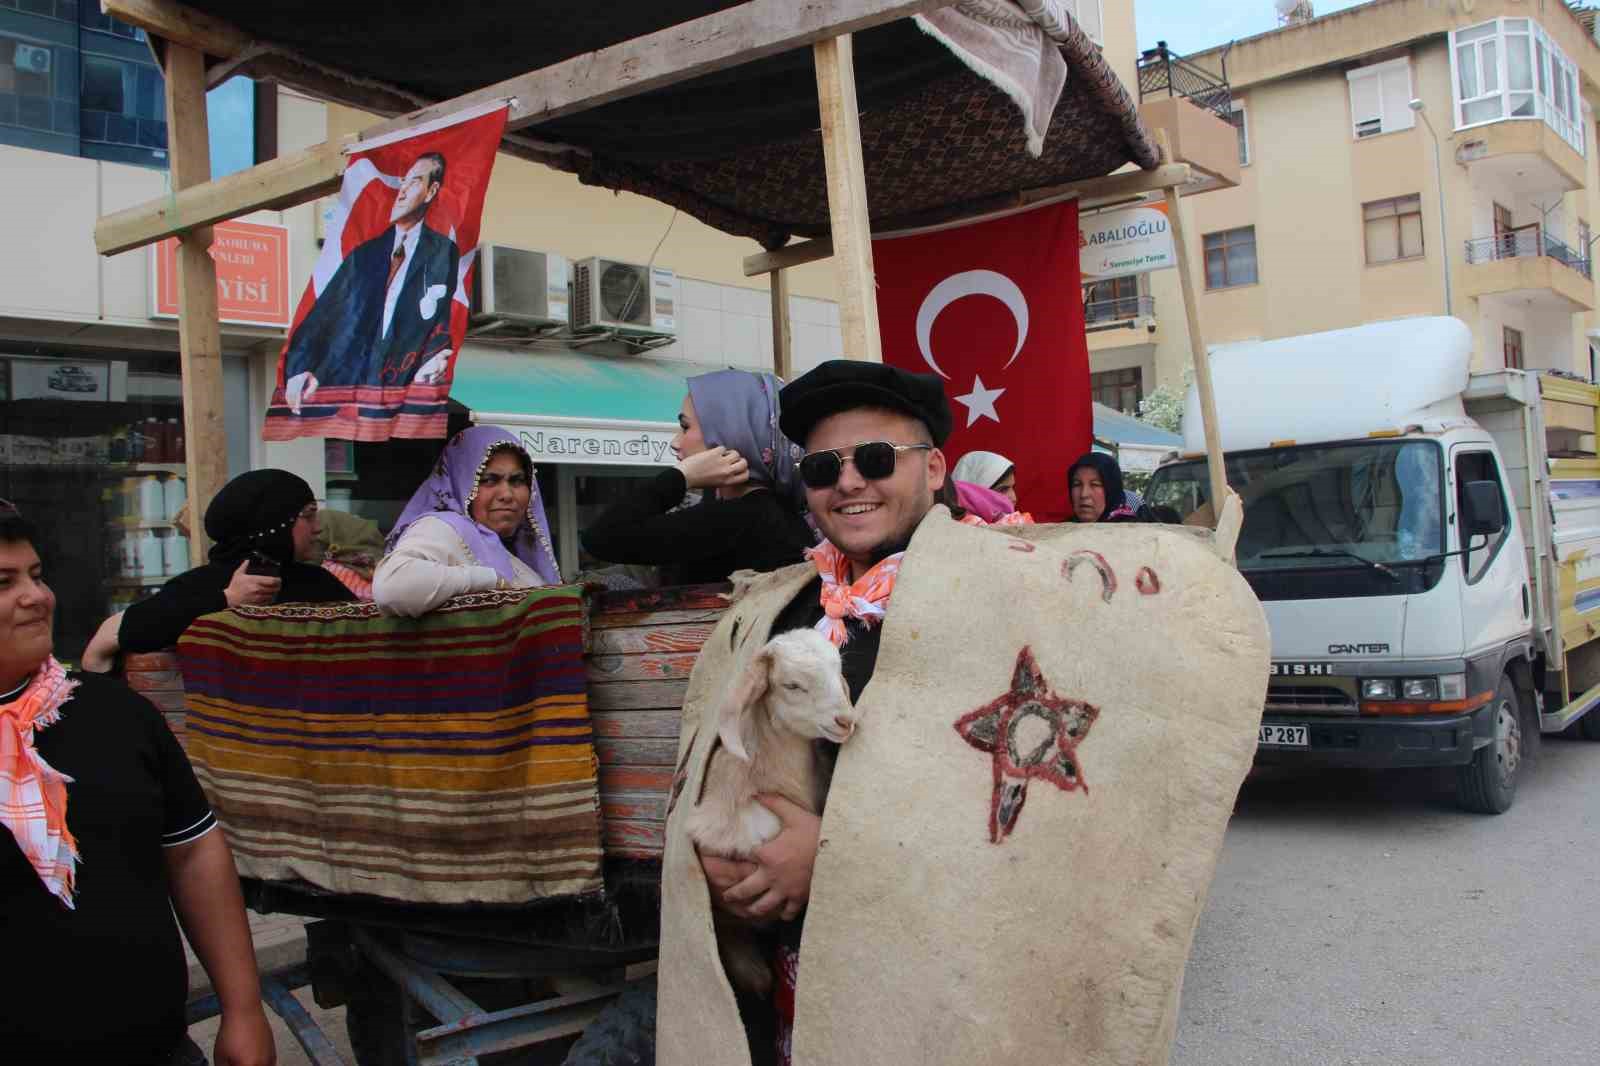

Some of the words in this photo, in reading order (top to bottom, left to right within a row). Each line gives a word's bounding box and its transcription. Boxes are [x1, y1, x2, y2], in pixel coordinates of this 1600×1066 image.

[519, 430, 675, 462] Narenciy
[1328, 643, 1389, 654] CANTER
[1277, 727, 1305, 743] 287
